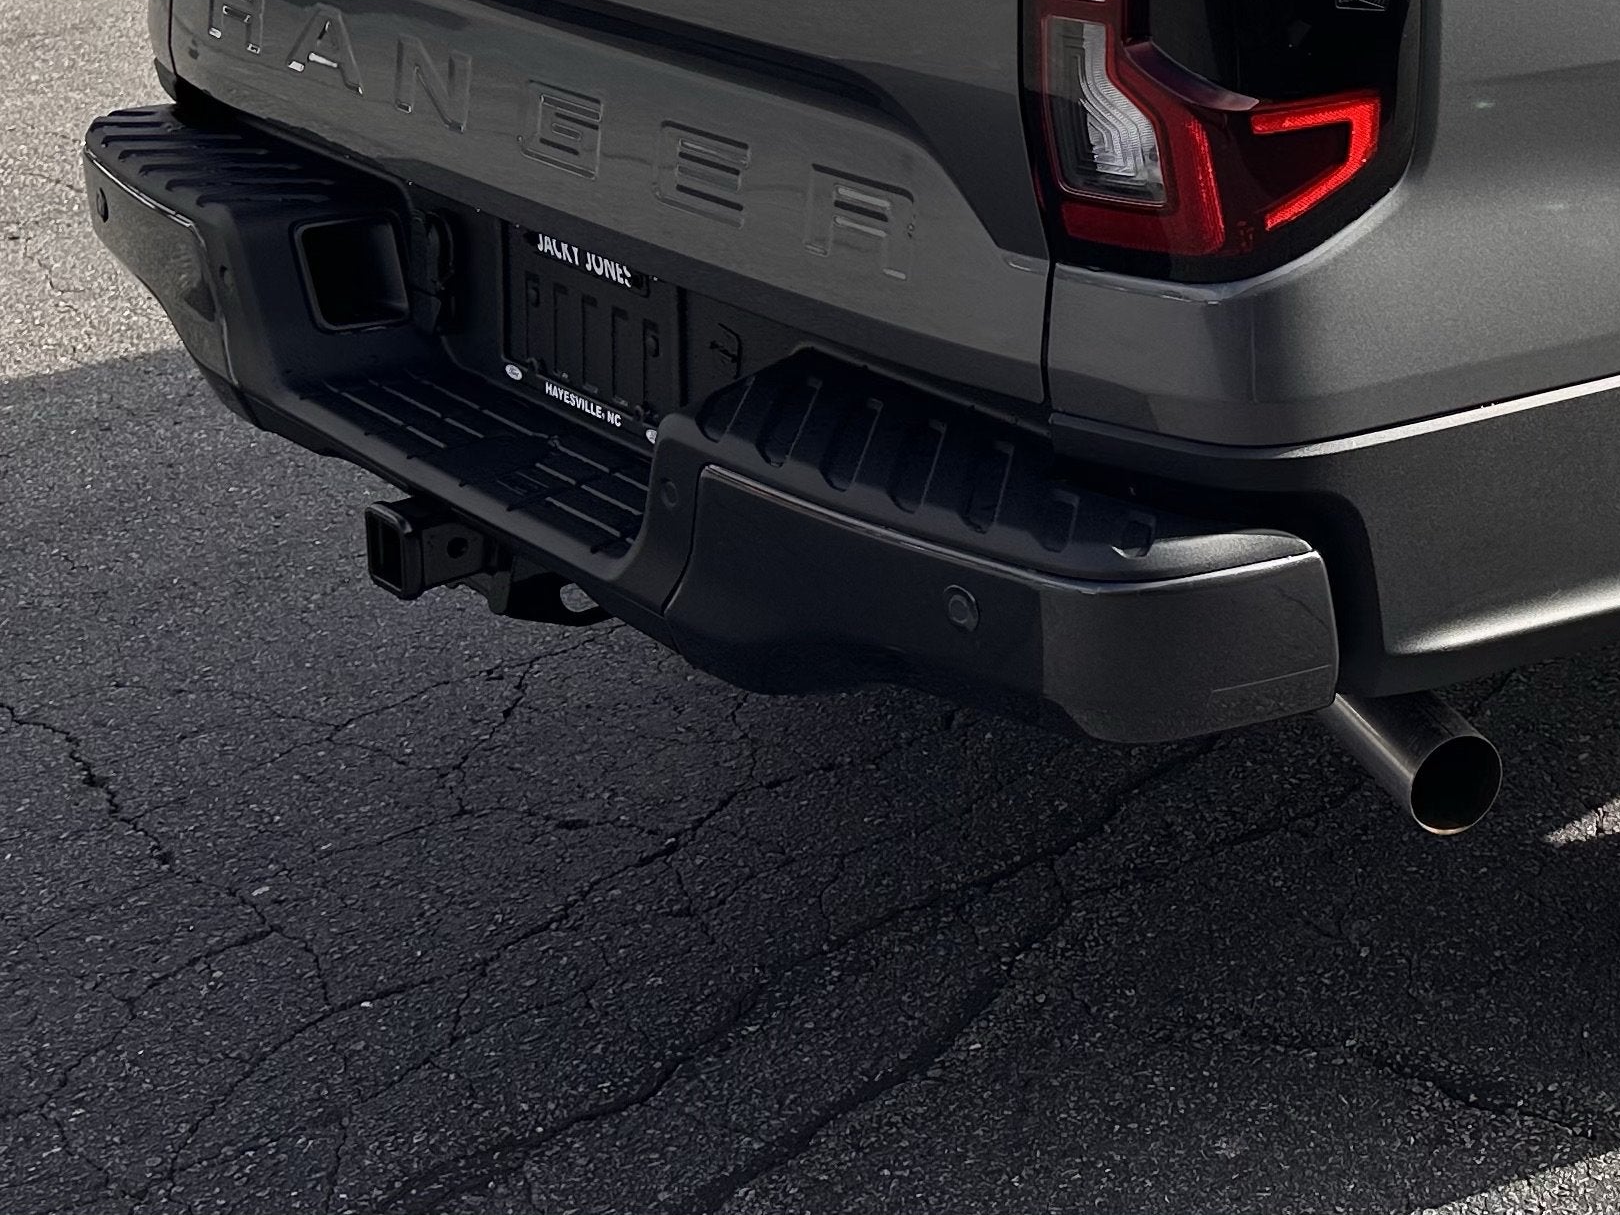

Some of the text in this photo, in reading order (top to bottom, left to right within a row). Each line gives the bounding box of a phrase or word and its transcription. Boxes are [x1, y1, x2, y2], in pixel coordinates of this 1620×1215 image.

[537, 233, 632, 288] JACKY JONES
[607, 409, 622, 428] NC
